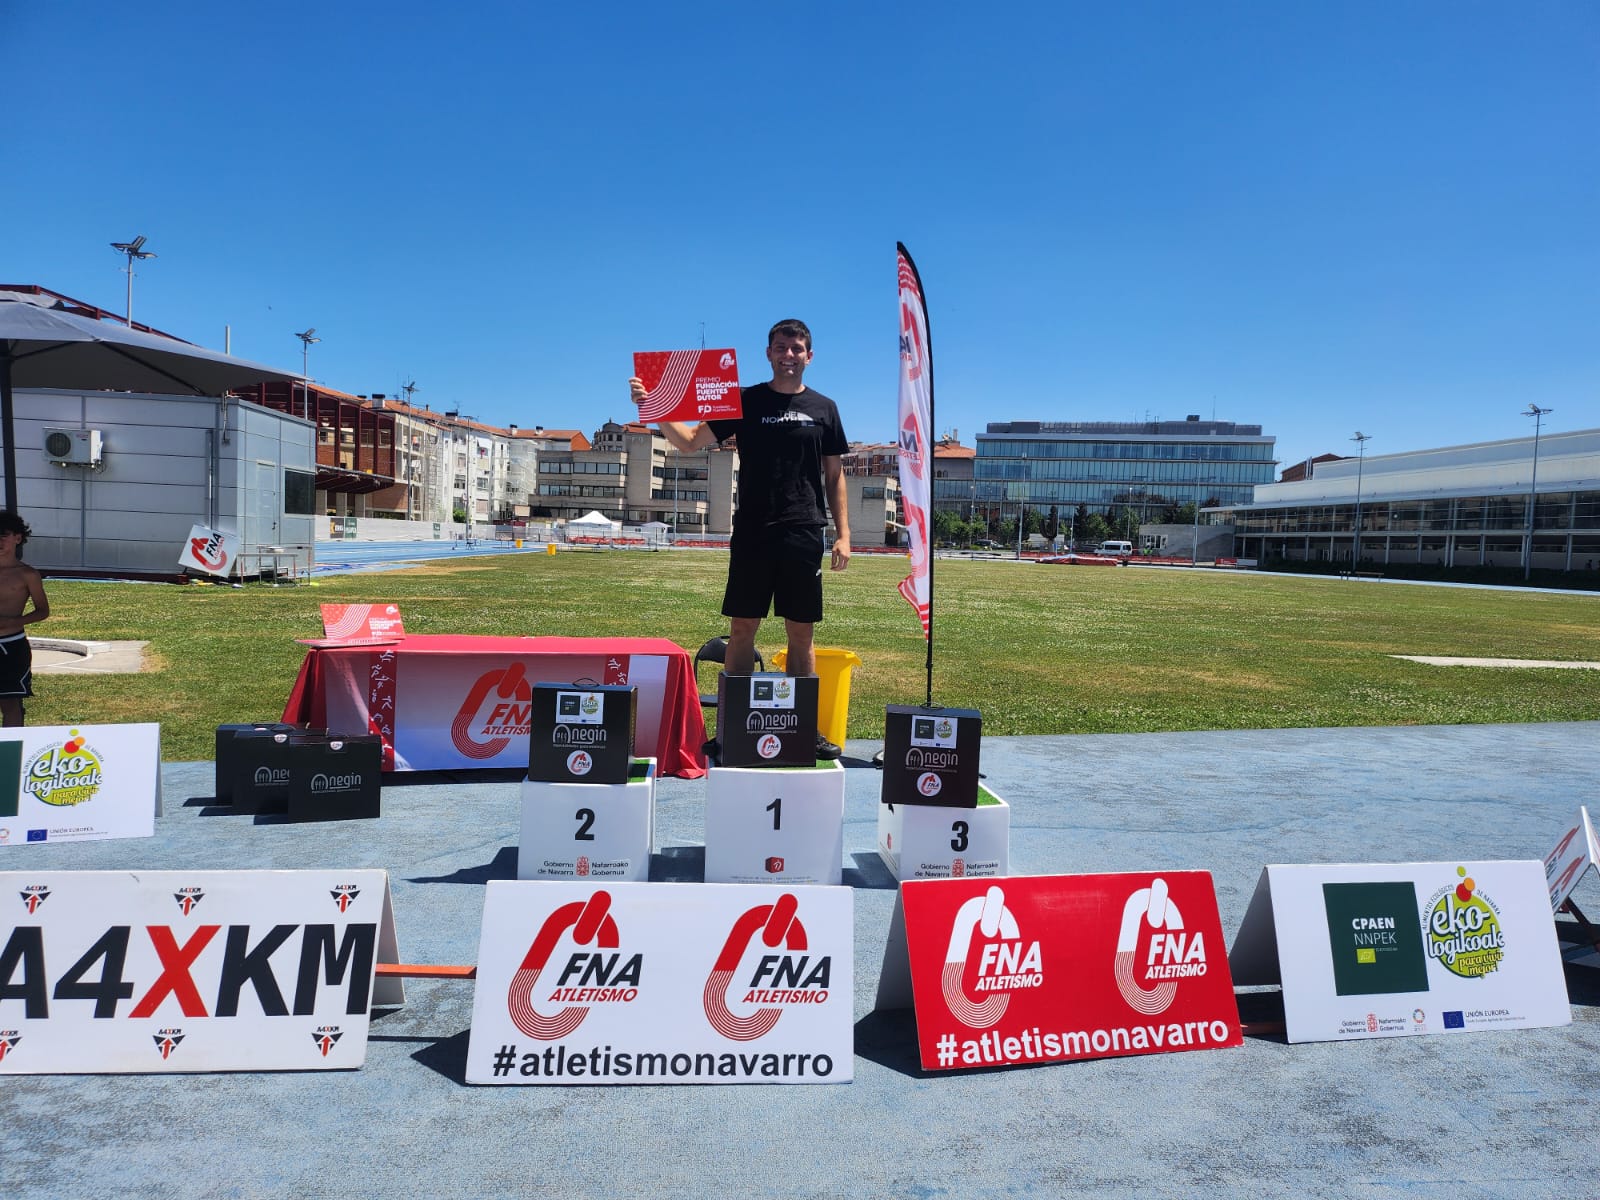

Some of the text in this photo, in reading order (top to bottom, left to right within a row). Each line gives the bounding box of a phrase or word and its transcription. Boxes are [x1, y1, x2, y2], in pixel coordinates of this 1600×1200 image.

[696, 381, 738, 389] FUNDACIÓN
[206, 533, 222, 557] FNA
[481, 726, 531, 735] ATLETISM
[24, 769, 103, 797] logikoak
[574, 808, 596, 841] 2
[766, 798, 782, 830] 1
[950, 820, 969, 852] 3
[543, 860, 574, 868] Gobierno
[1352, 917, 1395, 930] CPAEN
[1148, 932, 1207, 966] FNA
[1354, 931, 1397, 945] NNPEK
[1426, 923, 1506, 965] logikoak
[0, 923, 377, 1019] A4XKM
[557, 953, 643, 986] FNA
[750, 955, 832, 989] FNA
[978, 941, 1043, 976] FNA
[1144, 963, 1208, 980] ATLETISMO
[548, 988, 639, 1002] ATLETISMO
[974, 973, 1044, 991] ATLETISMO
[742, 989, 829, 1004] ATLETISMO
[1465, 1008, 1510, 1018] UNIÓN EUROPEA
[936, 1020, 1229, 1066] #atletismonavarro
[492, 1045, 834, 1077] #atletismonavarro
